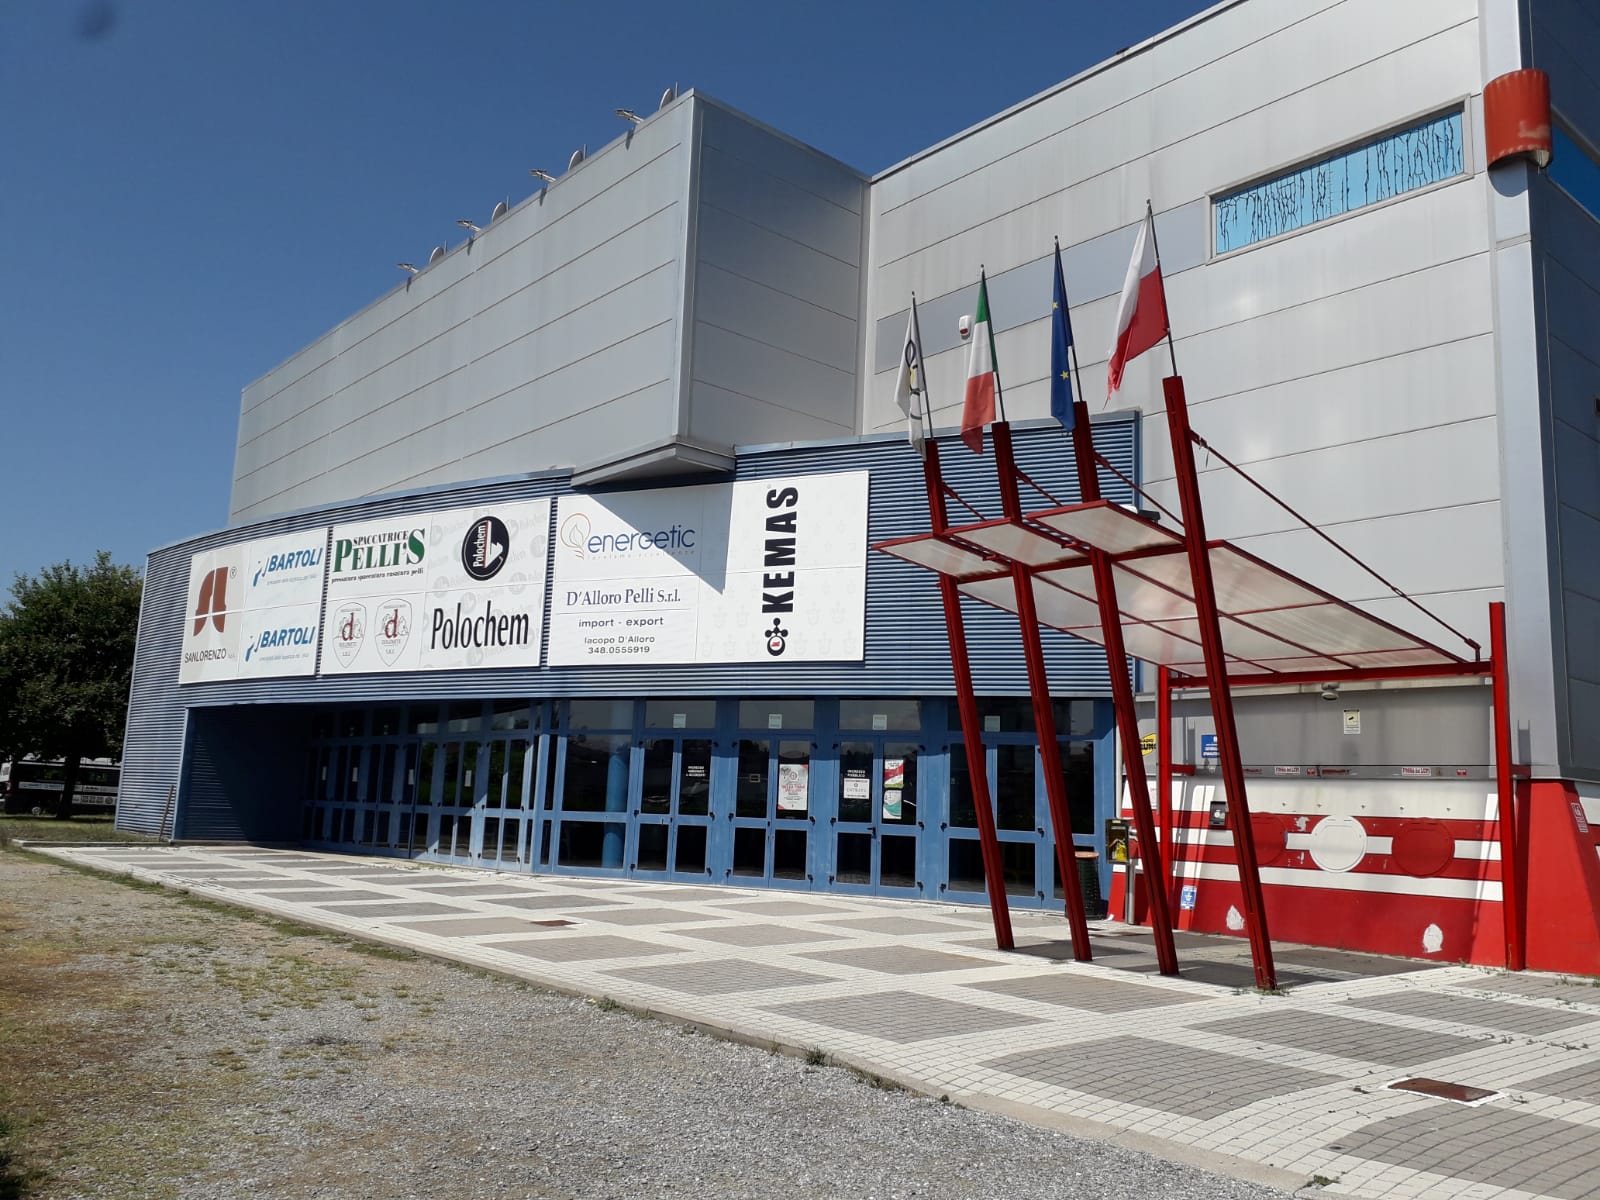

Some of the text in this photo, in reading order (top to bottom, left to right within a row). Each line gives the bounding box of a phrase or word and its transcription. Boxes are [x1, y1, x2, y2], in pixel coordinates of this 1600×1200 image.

[353, 530, 409, 546] SPACCATRICE
[472, 524, 487, 567] Polochem
[268, 548, 323, 572] BARTOLI
[333, 528, 425, 572] PELLI'S
[762, 487, 798, 613] KEMAS
[566, 588, 681, 606] D'Alloro Pelli S.r.l.
[431, 600, 529, 649] Polochem
[578, 619, 614, 629] import
[626, 617, 664, 628] export
[260, 626, 316, 648] BARTOLI
[618, 635, 655, 644] D'Alloro
[184, 648, 227, 663] SANLORENZO
